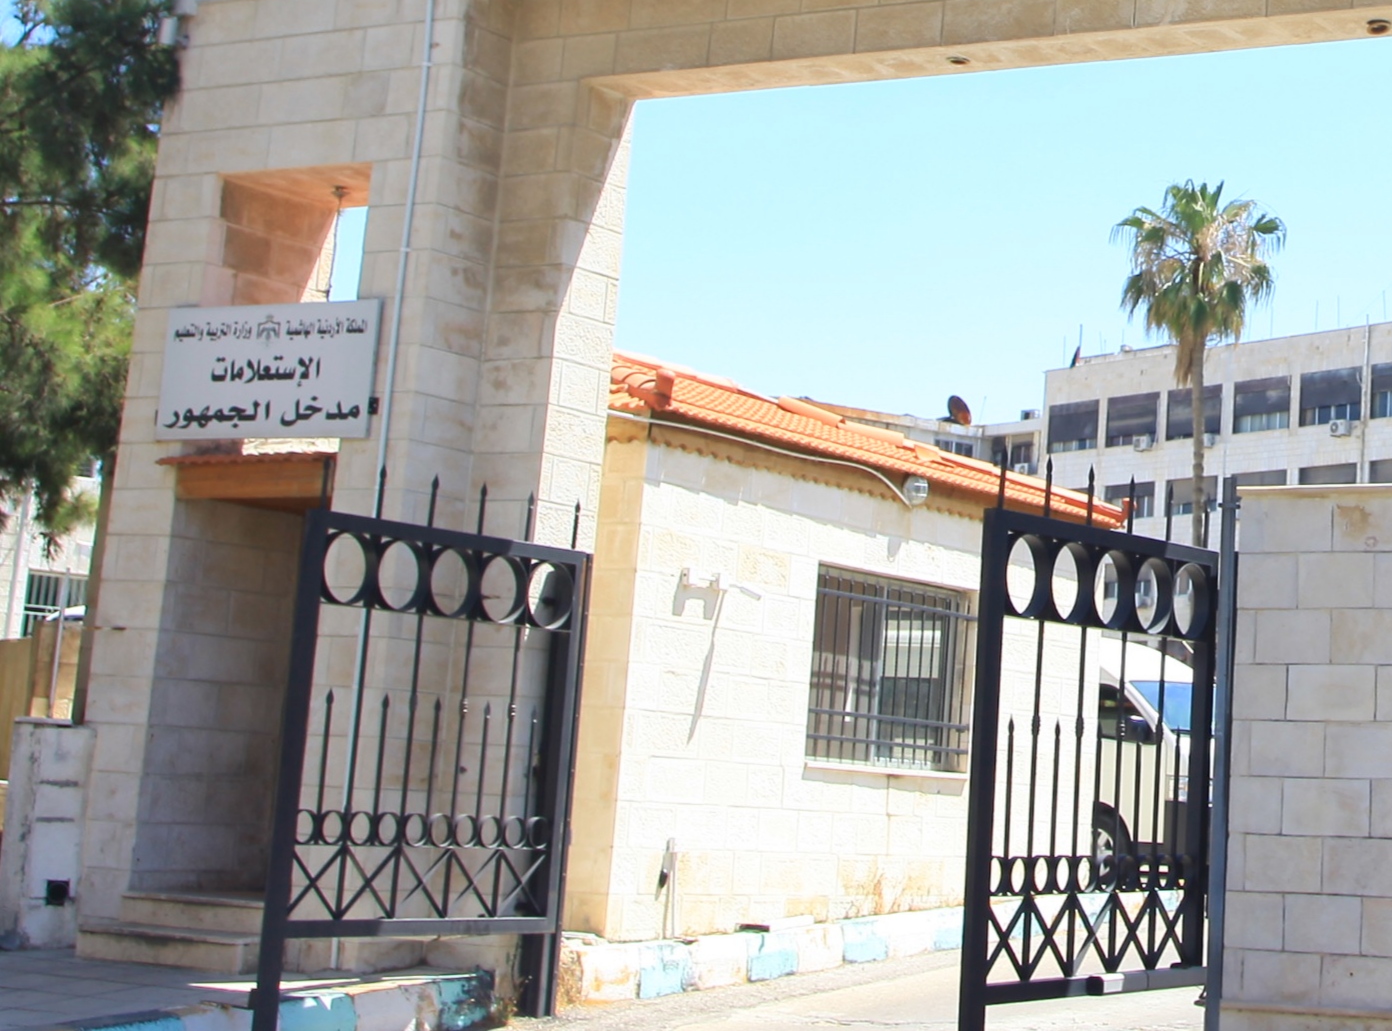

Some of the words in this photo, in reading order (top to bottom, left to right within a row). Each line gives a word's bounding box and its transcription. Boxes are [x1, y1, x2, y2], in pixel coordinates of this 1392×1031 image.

[211, 355, 321, 387] الإستعلامات
[163, 399, 271, 429] الجمهور
[280, 396, 361, 427] مدخل
